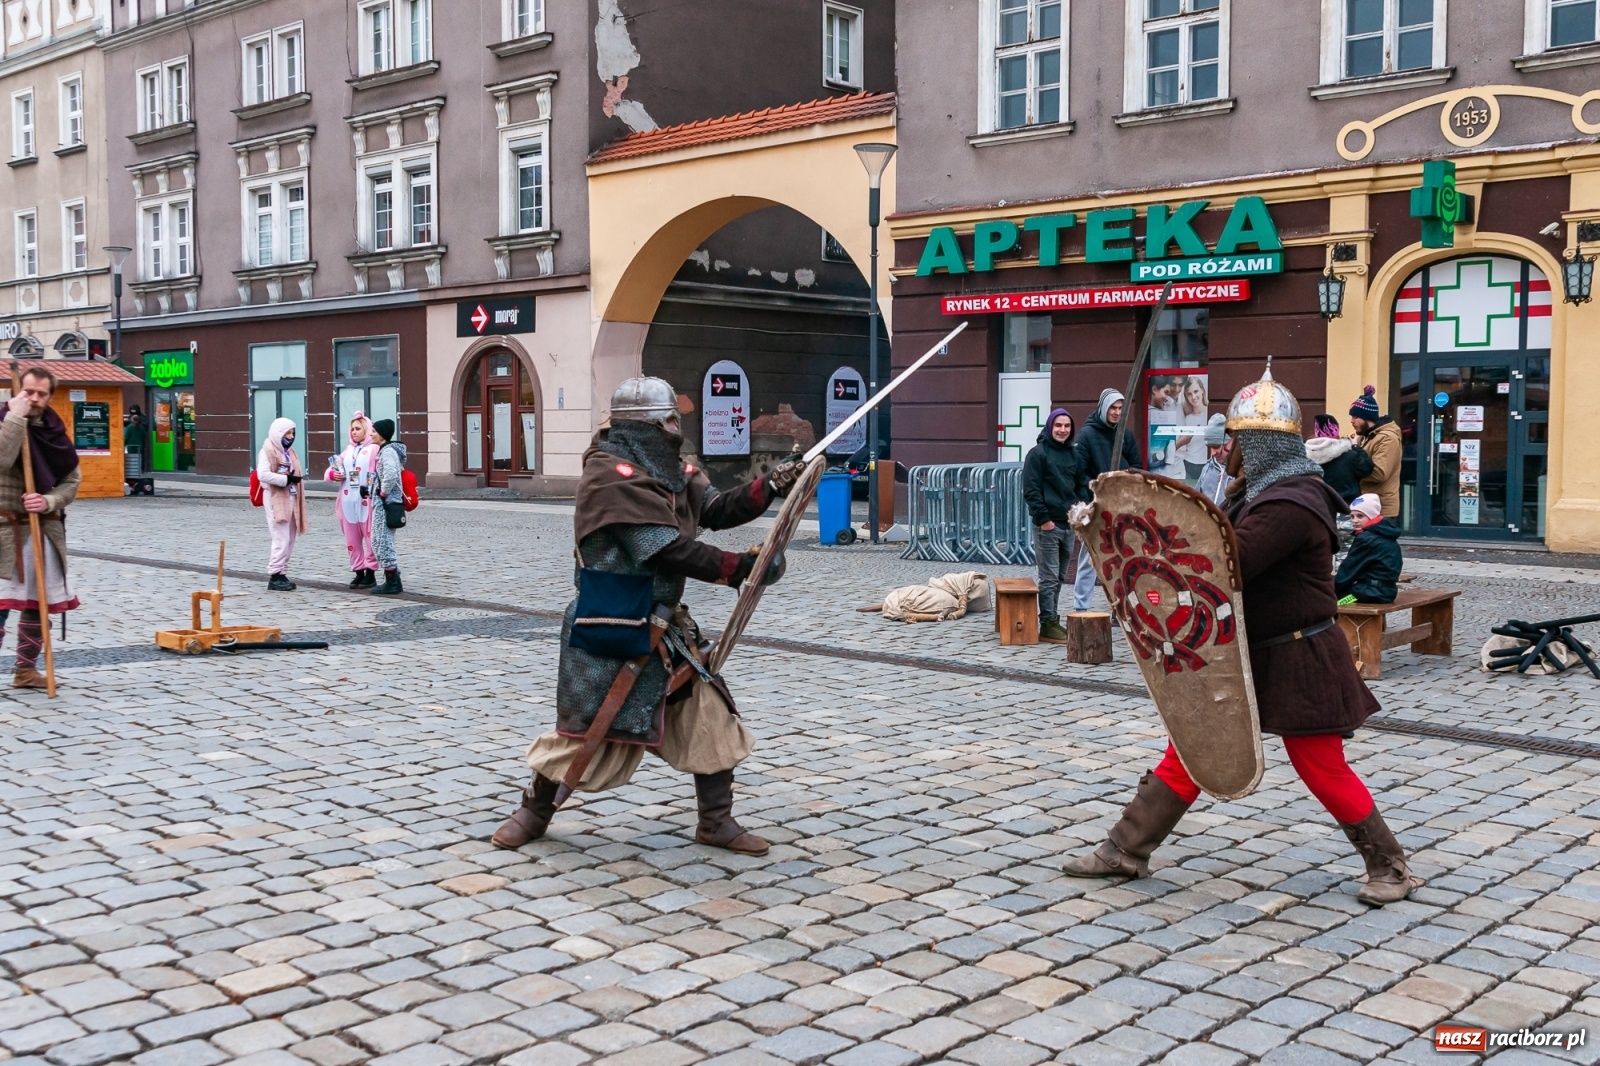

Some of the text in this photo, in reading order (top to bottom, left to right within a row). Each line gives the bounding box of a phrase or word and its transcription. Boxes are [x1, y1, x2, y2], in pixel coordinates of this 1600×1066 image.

[1467, 100, 1474, 110] A
[1454, 109, 1488, 127] 1953
[1466, 127, 1474, 137] D
[915, 196, 1284, 277] APTEKA
[1139, 257, 1273, 278] POD RÓŻAMI
[946, 298, 990, 312] RYNEK
[994, 297, 1010, 310] 12
[1021, 292, 1089, 308] CENTRUM
[150, 358, 187, 378] żabka
